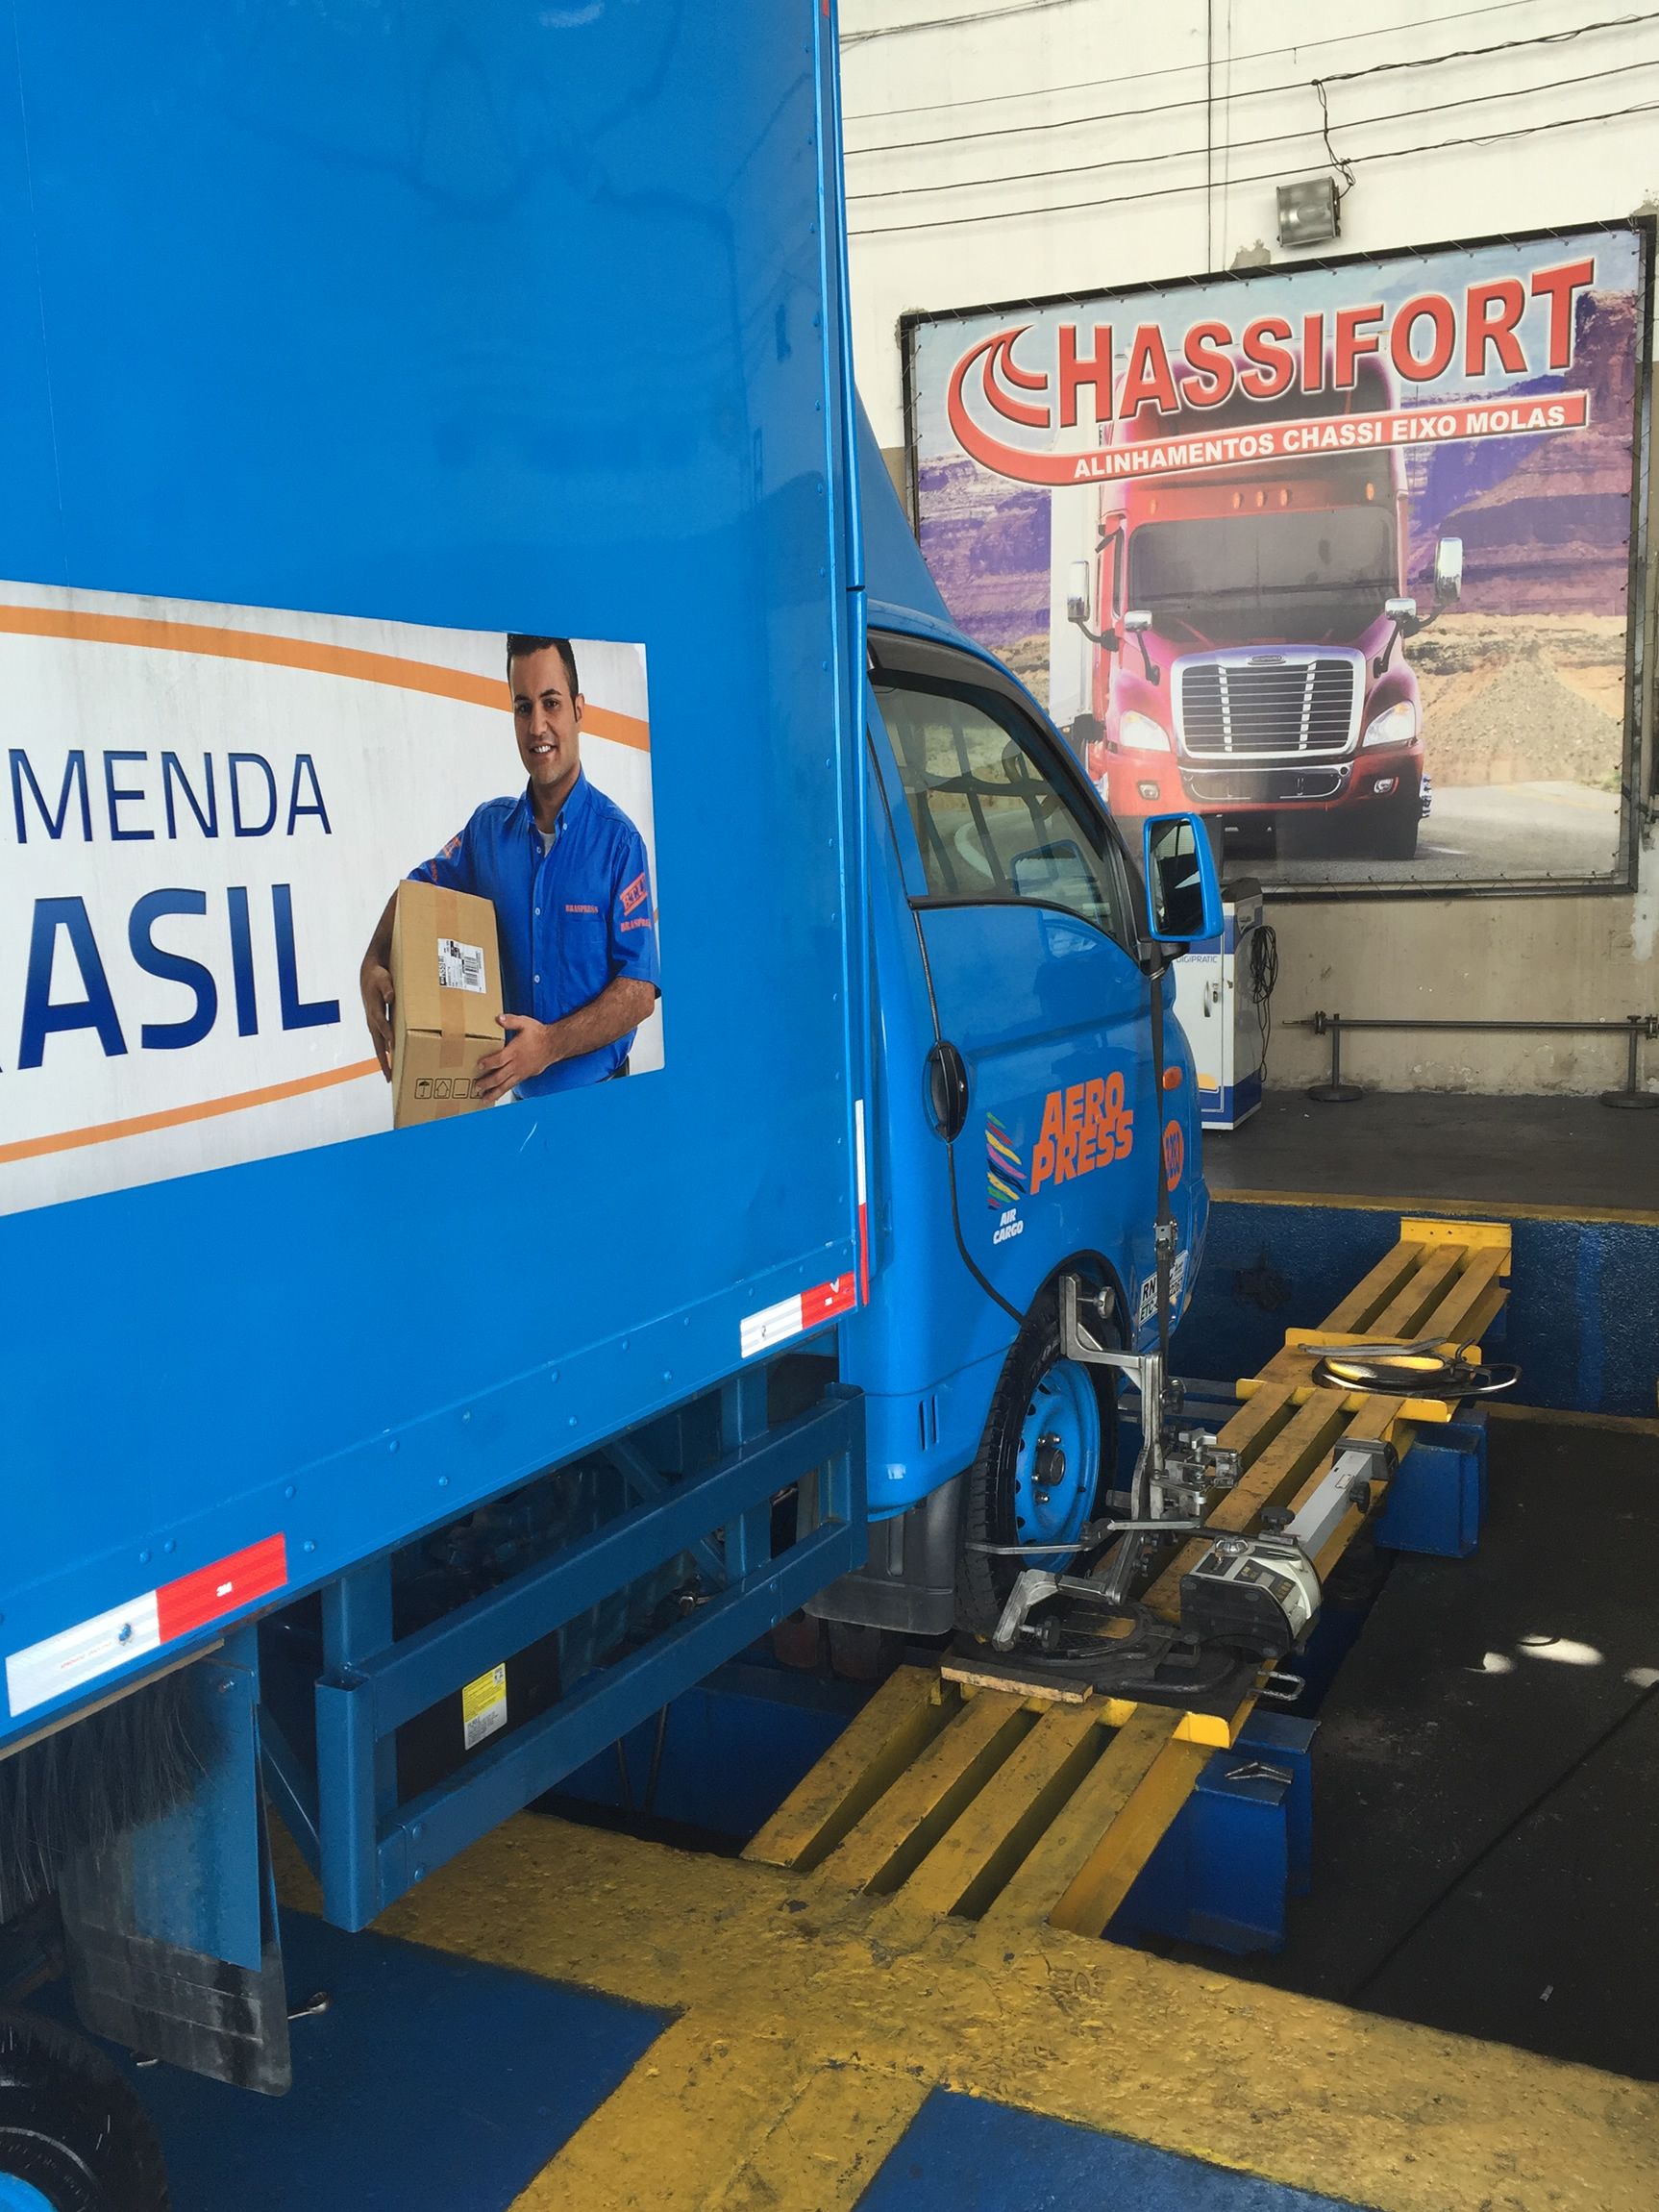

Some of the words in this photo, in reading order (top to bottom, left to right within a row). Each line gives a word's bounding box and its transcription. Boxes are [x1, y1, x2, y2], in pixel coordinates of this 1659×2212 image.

[948, 257, 1596, 466] CHASSIFORT
[1073, 433, 1275, 479] ALINHAMENTOS
[1282, 417, 1382, 452] CHASSI
[1392, 414, 1456, 440] EIXO
[1466, 406, 1565, 434] MOLAS
[8, 748, 333, 844] MENDA
[0, 882, 341, 1072] ASIL
[1039, 1070, 1125, 1144] AERO
[1029, 1109, 1133, 1195] PRESS
[993, 1220, 1024, 1245] CARGO
[1000, 1207, 1017, 1228] AIR
